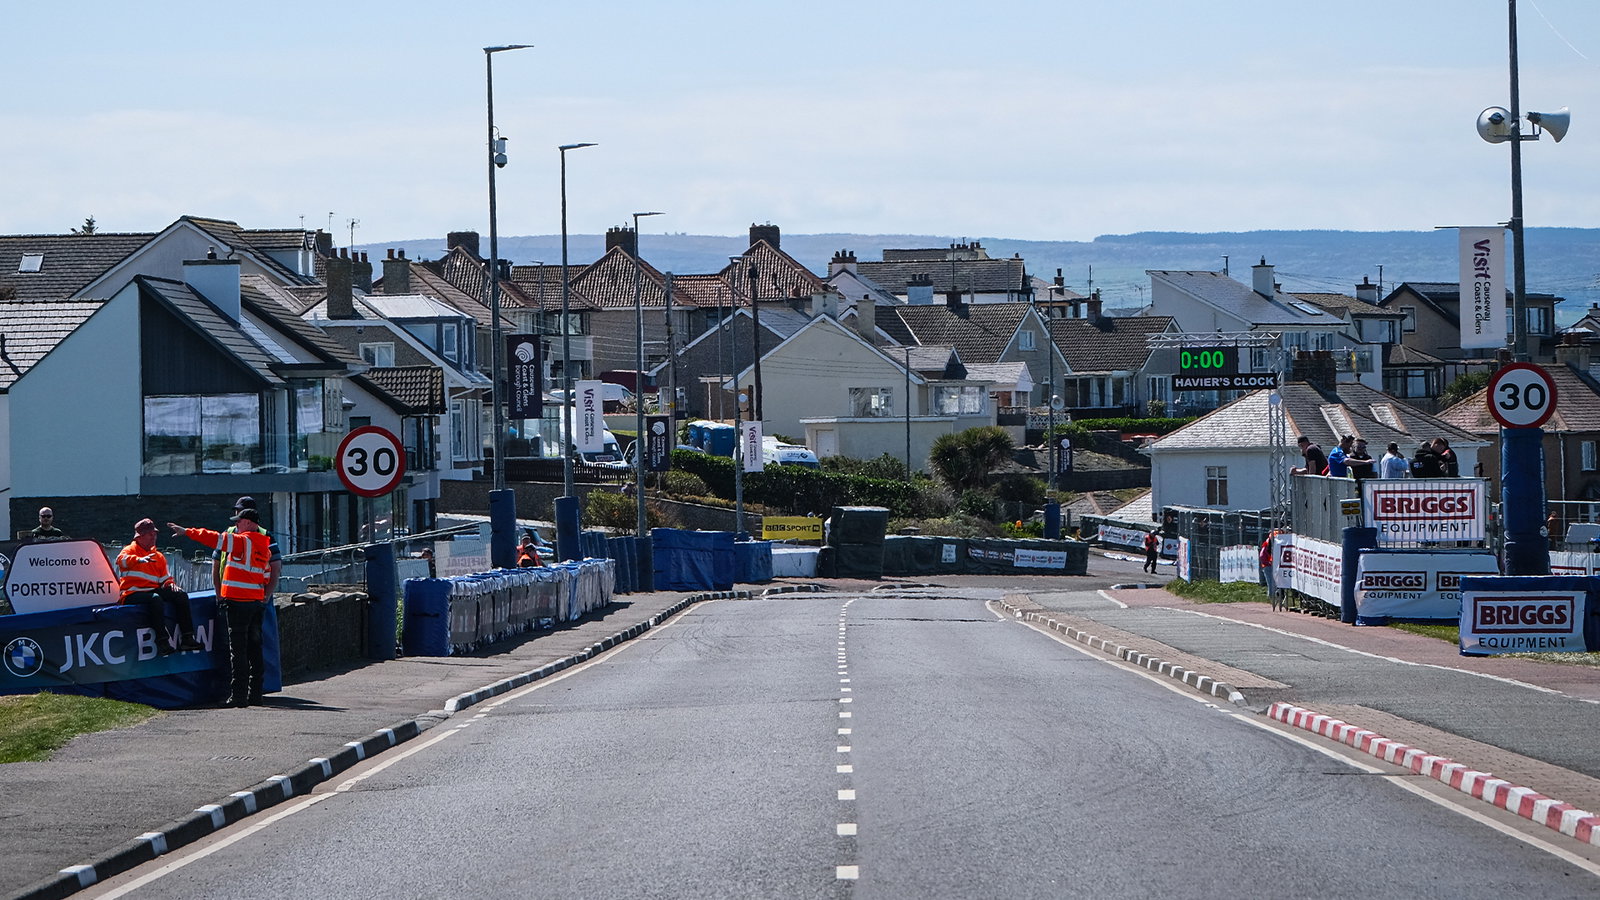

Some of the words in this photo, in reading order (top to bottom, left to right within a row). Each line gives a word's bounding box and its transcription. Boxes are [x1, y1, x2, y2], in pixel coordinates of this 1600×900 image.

[1473, 239, 1491, 279] Visit
[1482, 281, 1491, 321] Causeway
[1181, 350, 1224, 369] 0:00
[514, 364, 522, 389] Borough
[1175, 377, 1230, 387] HAVIER'S
[1233, 376, 1274, 386] CLOCK
[584, 388, 595, 412] Visit
[1499, 383, 1546, 410] 30
[347, 447, 396, 476] 30
[1381, 496, 1468, 514] BRIGGS
[1381, 522, 1468, 533] EQUIPMENT
[29, 557, 77, 567] Welcome
[80, 557, 91, 566] to
[11, 580, 114, 597] PORTSTEWART
[1365, 575, 1423, 587] BRIGGS
[1363, 592, 1423, 600] EQUIPMENT
[1480, 604, 1568, 625] BRIGGS
[59, 630, 126, 673] JKC
[1478, 637, 1567, 648] EQUIPMENT
